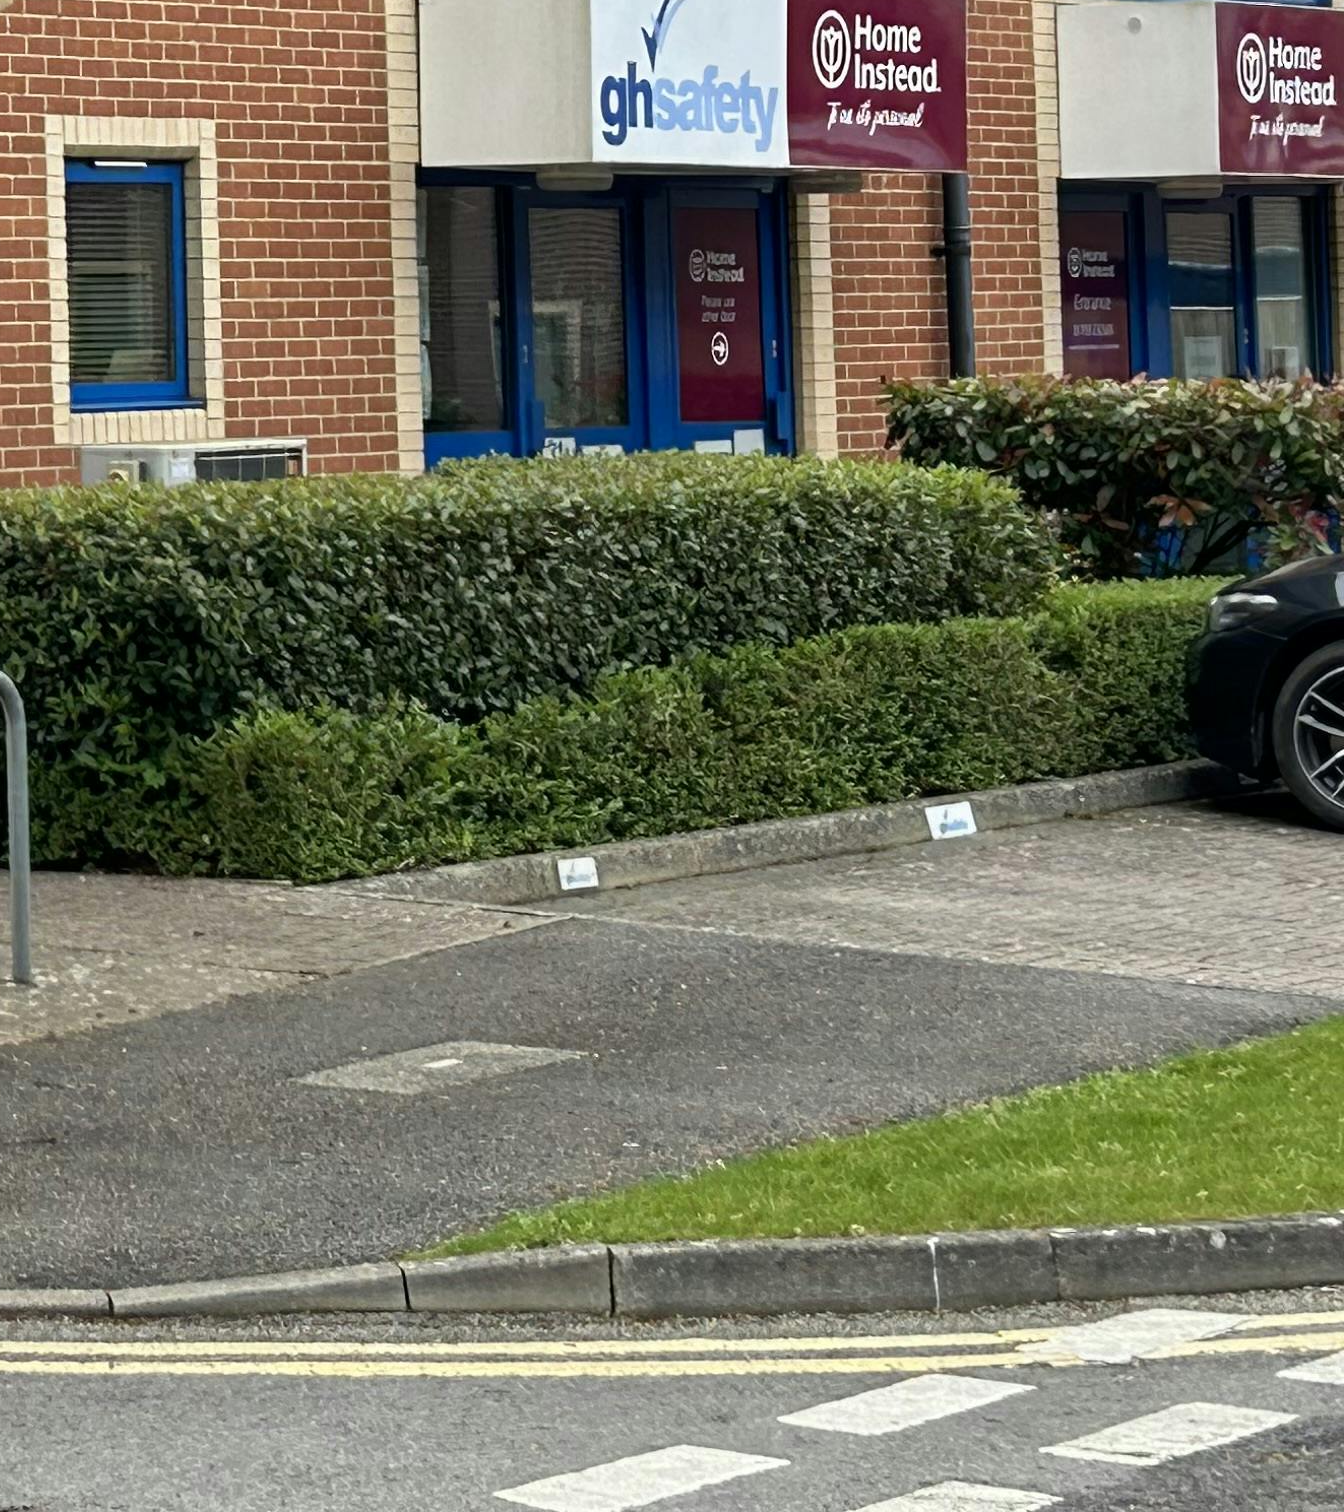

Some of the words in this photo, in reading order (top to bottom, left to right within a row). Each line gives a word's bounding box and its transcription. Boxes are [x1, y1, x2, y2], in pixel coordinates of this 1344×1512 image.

[854, 13, 922, 54] Home
[1268, 36, 1323, 71] Home
[854, 53, 942, 94] Instead
[1268, 72, 1337, 106] Instead
[600, 60, 779, 153] ghsafety
